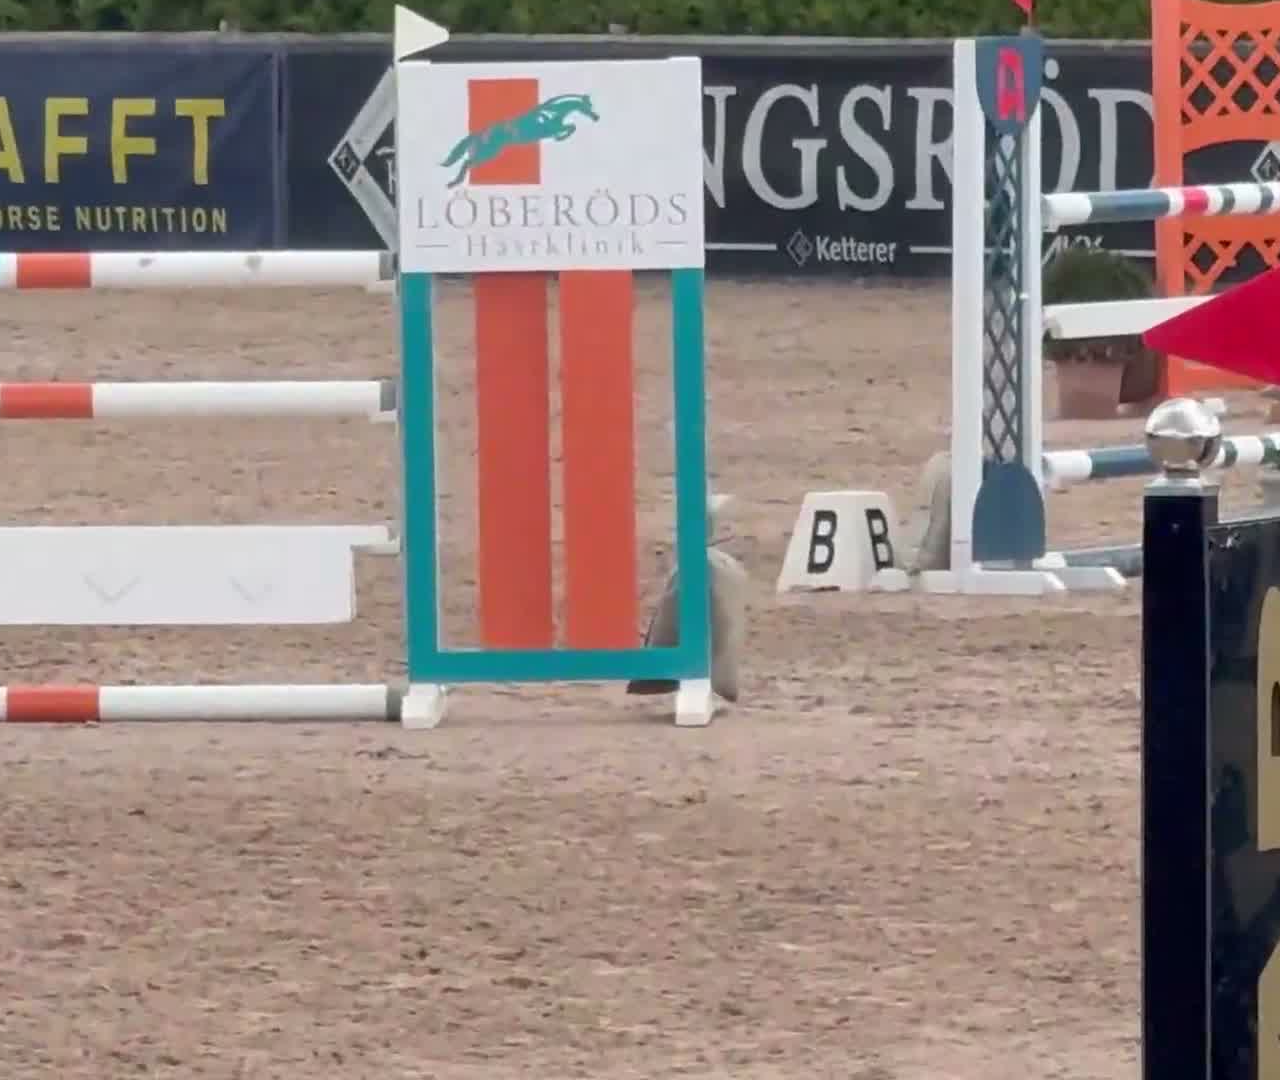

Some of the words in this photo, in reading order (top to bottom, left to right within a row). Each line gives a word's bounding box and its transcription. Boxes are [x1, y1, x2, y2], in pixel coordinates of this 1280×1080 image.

[75, 206, 227, 234] NUTRITION
[417, 189, 689, 230] LÖBERÖDS
[815, 235, 897, 264] Ketterer
[807, 509, 838, 574] B
[864, 508, 895, 572] B
